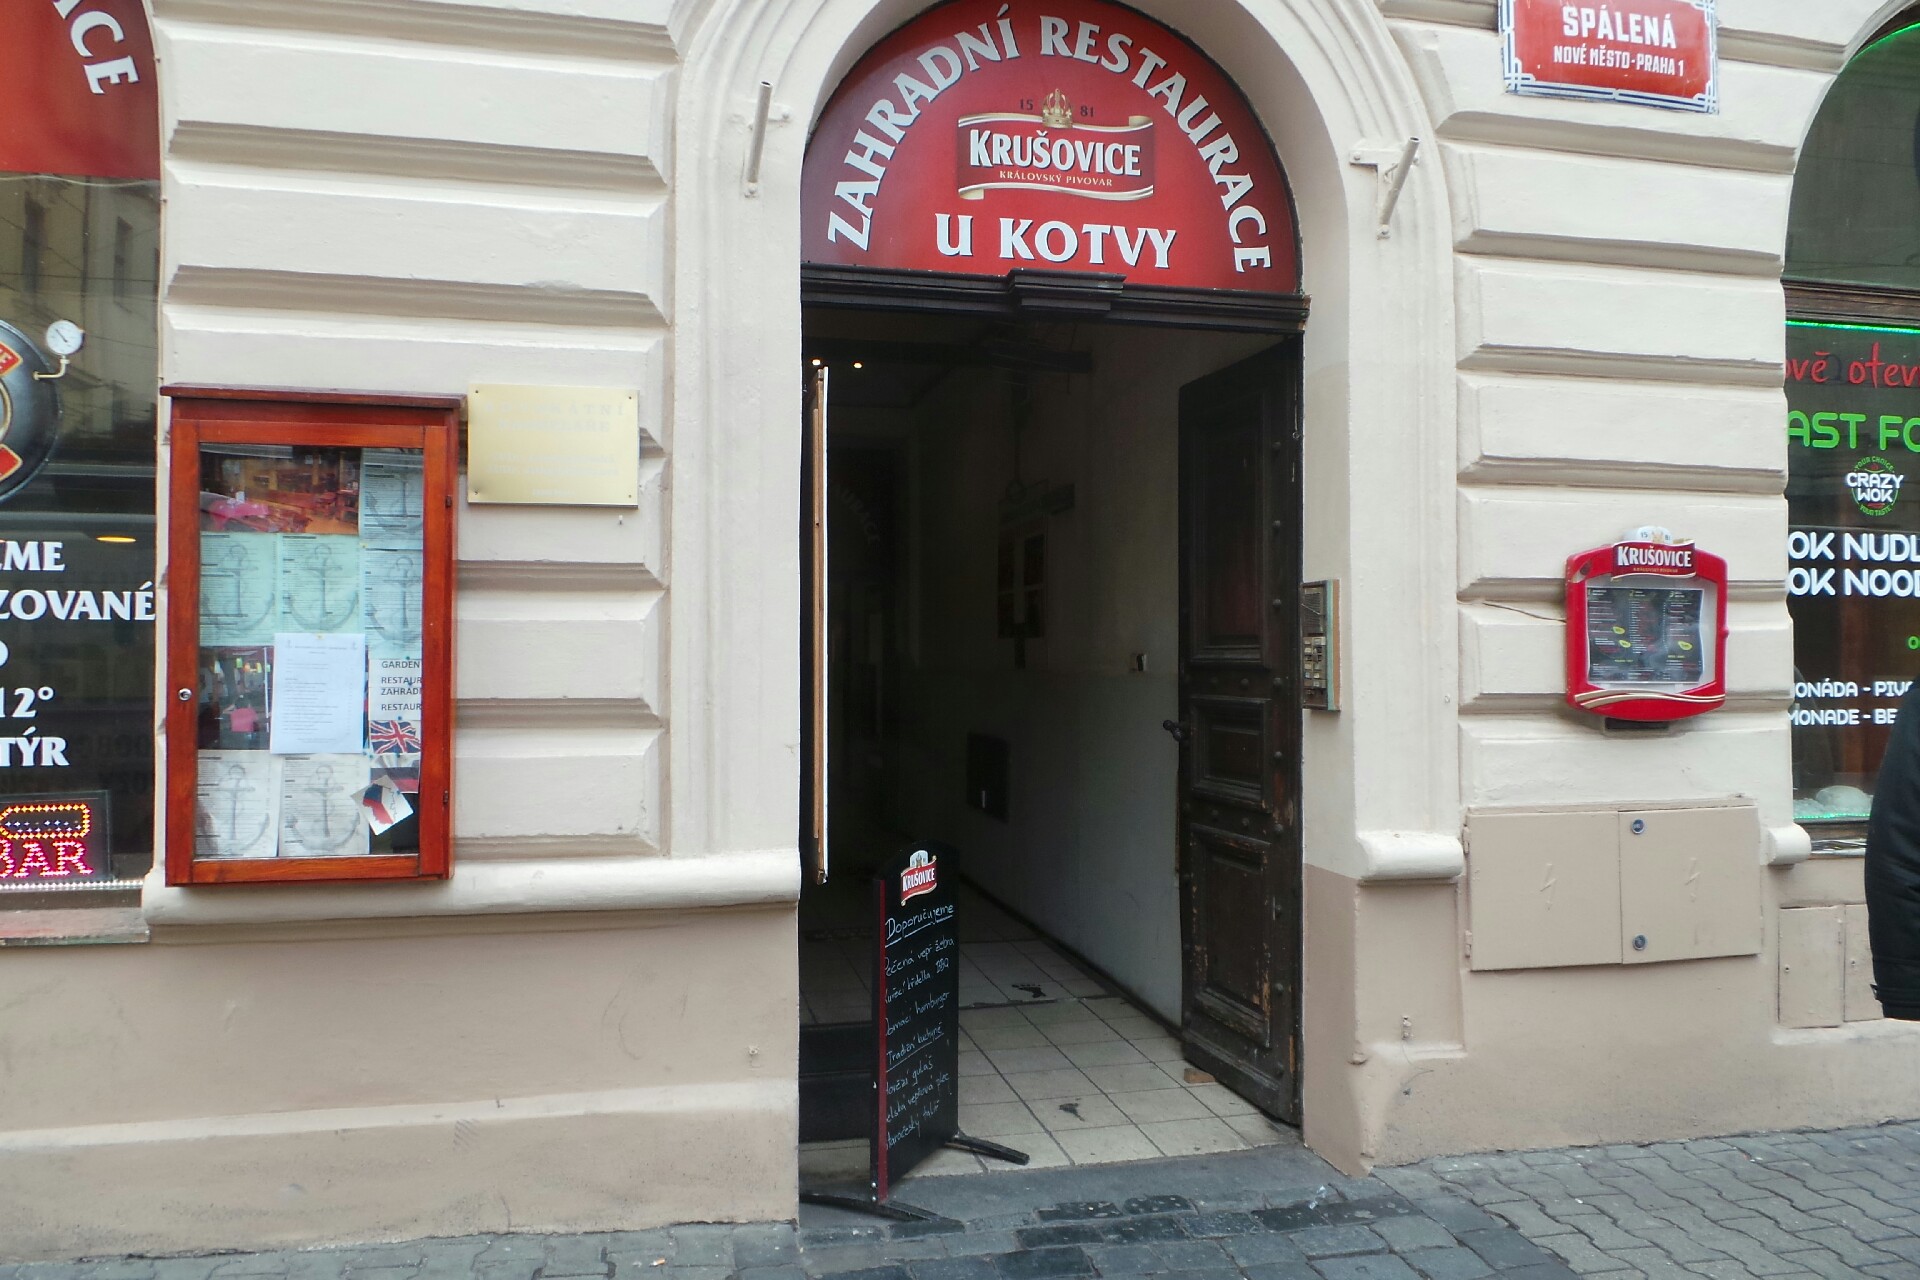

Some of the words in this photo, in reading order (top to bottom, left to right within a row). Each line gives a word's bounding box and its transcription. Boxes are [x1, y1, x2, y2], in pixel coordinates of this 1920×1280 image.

[1562, 5, 1677, 49] SPÁLENÁ
[1554, 43, 1587, 65] NOVÉ
[1678, 59, 1684, 77] 1
[1019, 98, 1034, 111] 15
[1080, 105, 1095, 118] 81
[827, 5, 1021, 251] ZAHRADNÍ
[1039, 15, 1271, 272] RESTAURACE
[969, 129, 1142, 177] KRUŠOVICE
[999, 170, 1062, 183] KRÁLOVSKÝ
[1066, 175, 1113, 186] PIVOVAR
[935, 212, 973, 257] U
[999, 217, 1177, 269] KOTVY
[1846, 472, 1904, 489] CRAZY
[1857, 488, 1894, 503] WOK
[0, 540, 66, 571] ME
[1617, 545, 1692, 567] KRUŠOVICE
[381, 661, 420, 669] GARDEN
[902, 868, 935, 892] KRUŠOVICE
[885, 904, 954, 940] Doporučujeme
